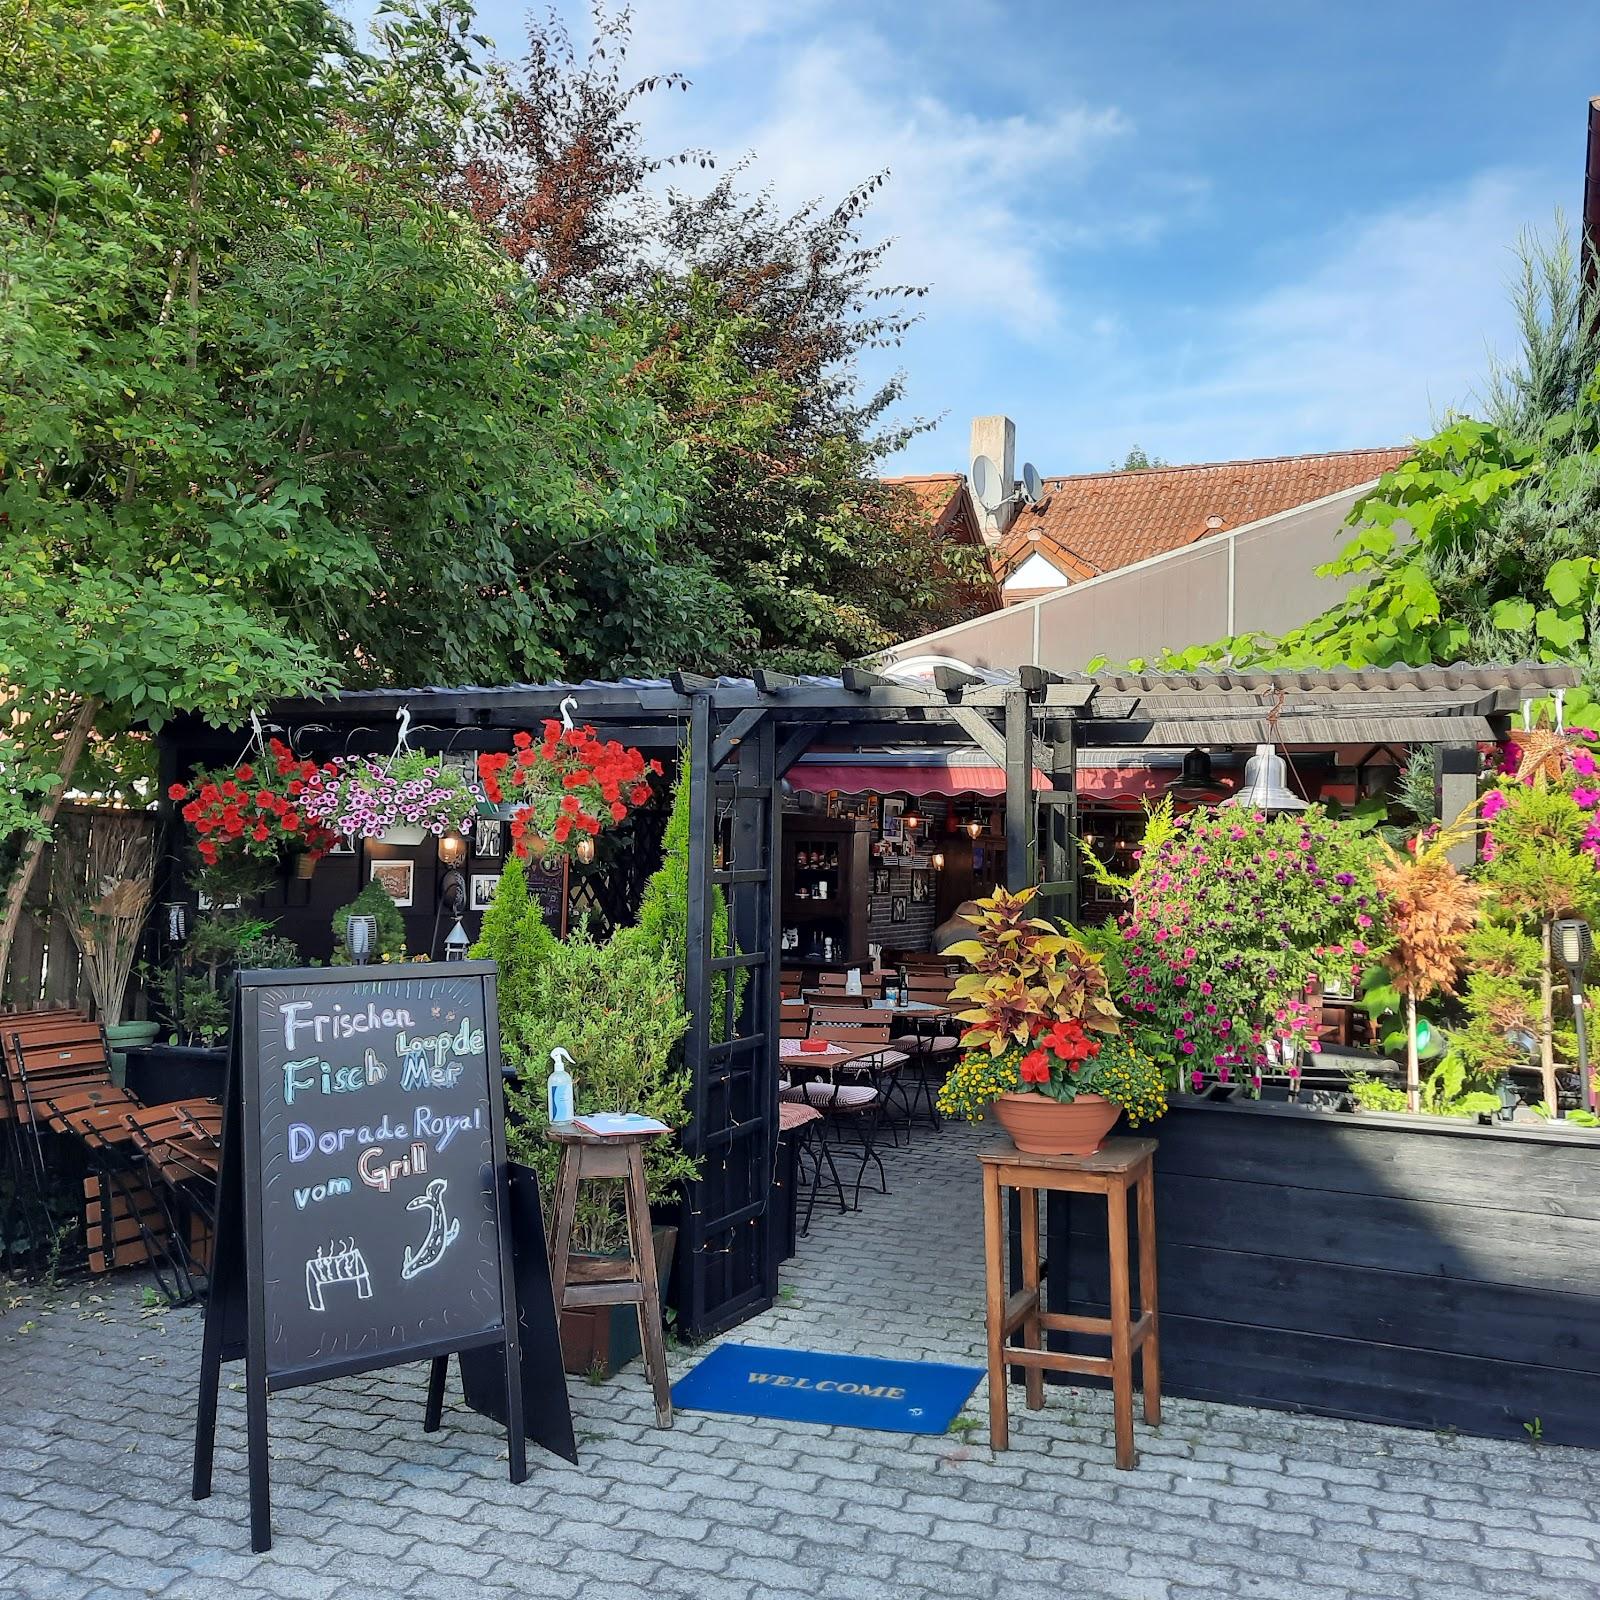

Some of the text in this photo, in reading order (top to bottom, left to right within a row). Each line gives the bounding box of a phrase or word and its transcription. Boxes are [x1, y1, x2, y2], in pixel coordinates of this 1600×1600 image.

[279, 1000, 416, 1052] Frischen
[281, 1047, 388, 1105] Fisch
[400, 1048, 464, 1092] Mer
[288, 1105, 482, 1163] Dorade Royal
[357, 1141, 428, 1193] Grill
[293, 1176, 352, 1211] vom
[747, 1371, 905, 1401] WELCOME
